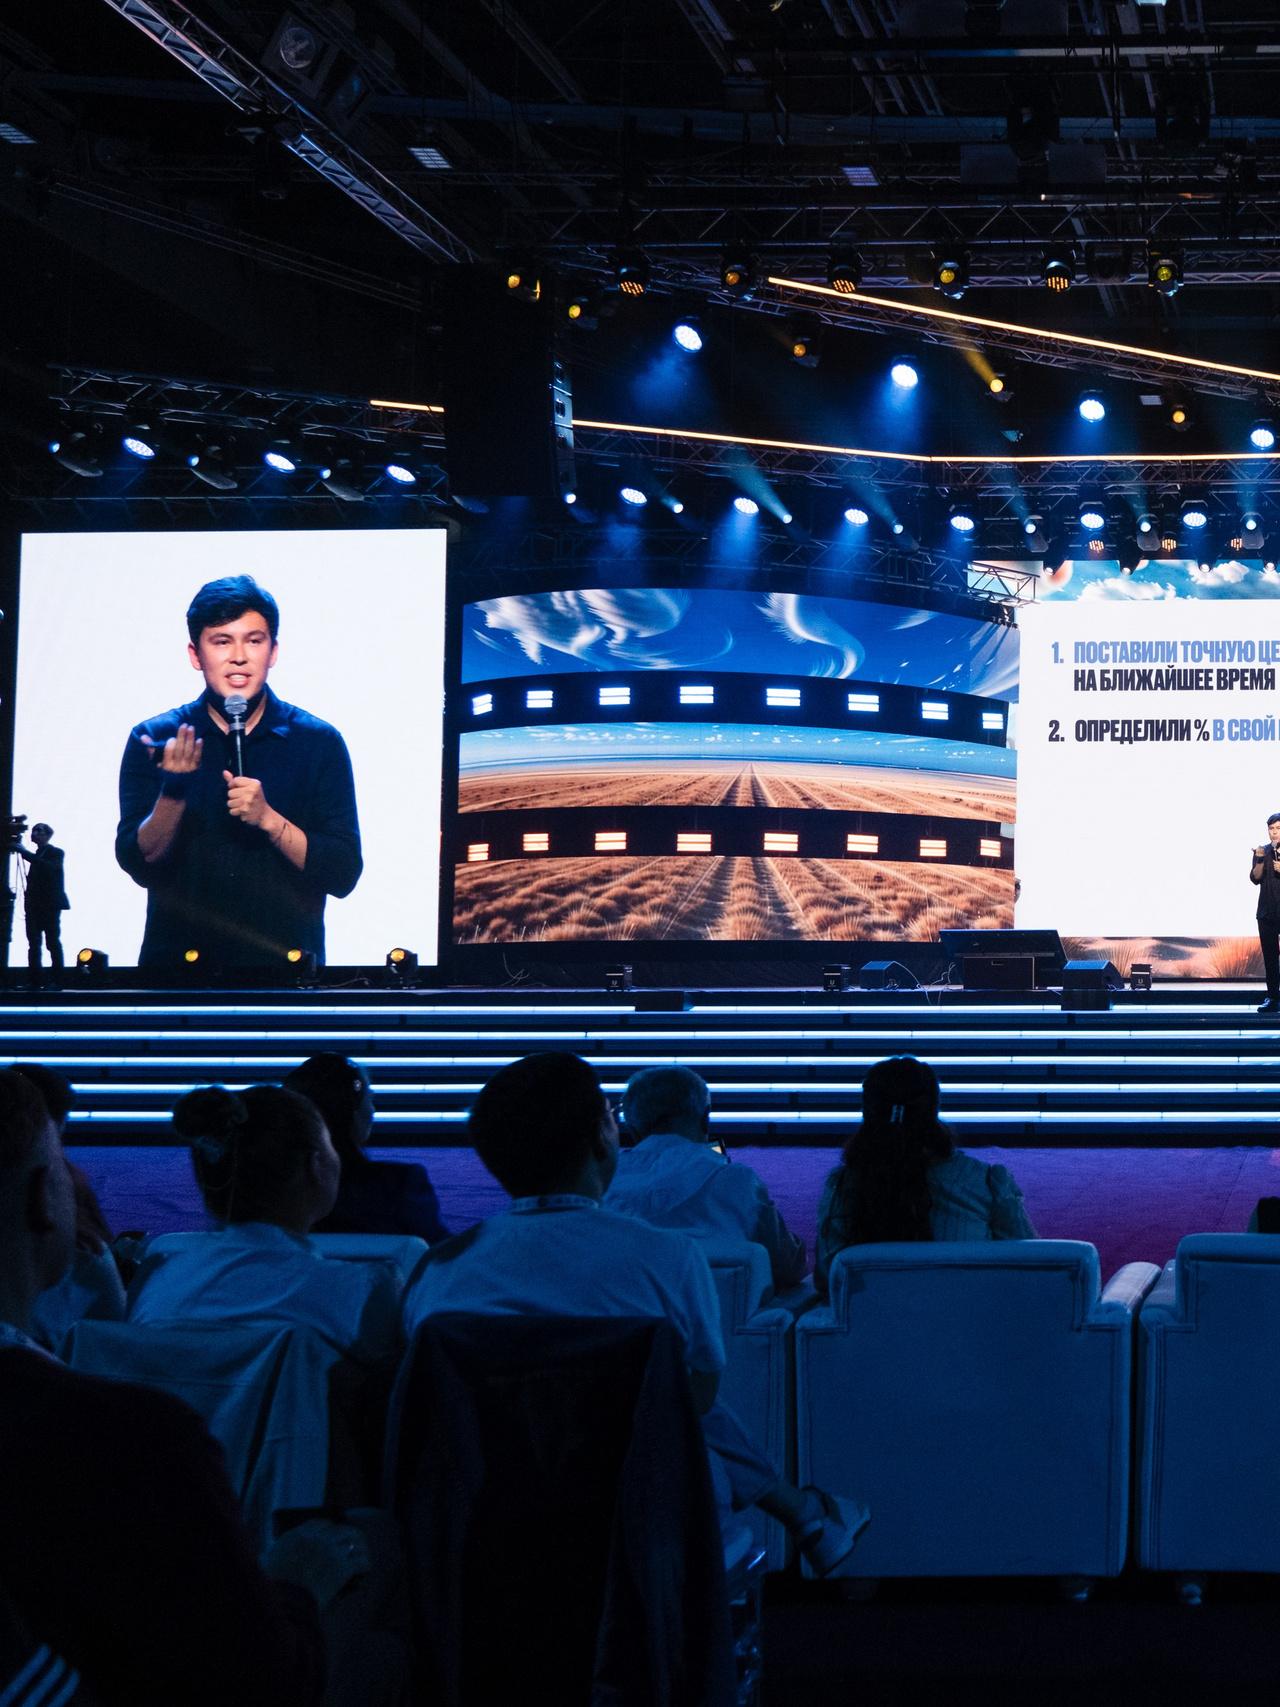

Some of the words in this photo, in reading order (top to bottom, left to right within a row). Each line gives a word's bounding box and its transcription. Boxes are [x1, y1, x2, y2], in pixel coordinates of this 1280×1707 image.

[1051, 641, 1065, 664] 1.
[1073, 640, 1178, 664] ПОСТАВИЛИ
[1180, 640, 1256, 664] ТОЧНУЮ
[1073, 669, 1098, 692] НА
[1099, 665, 1214, 692] БЛИЖАЙШЕЕ
[1216, 668, 1276, 691] ВРЕМЯ
[1048, 719, 1066, 742] 2.
[1075, 719, 1192, 745] ОПРЕДЕЛИЛИ
[1194, 719, 1211, 742] %
[1213, 718, 1225, 742] В
[1227, 715, 1275, 742] СВОЙ
